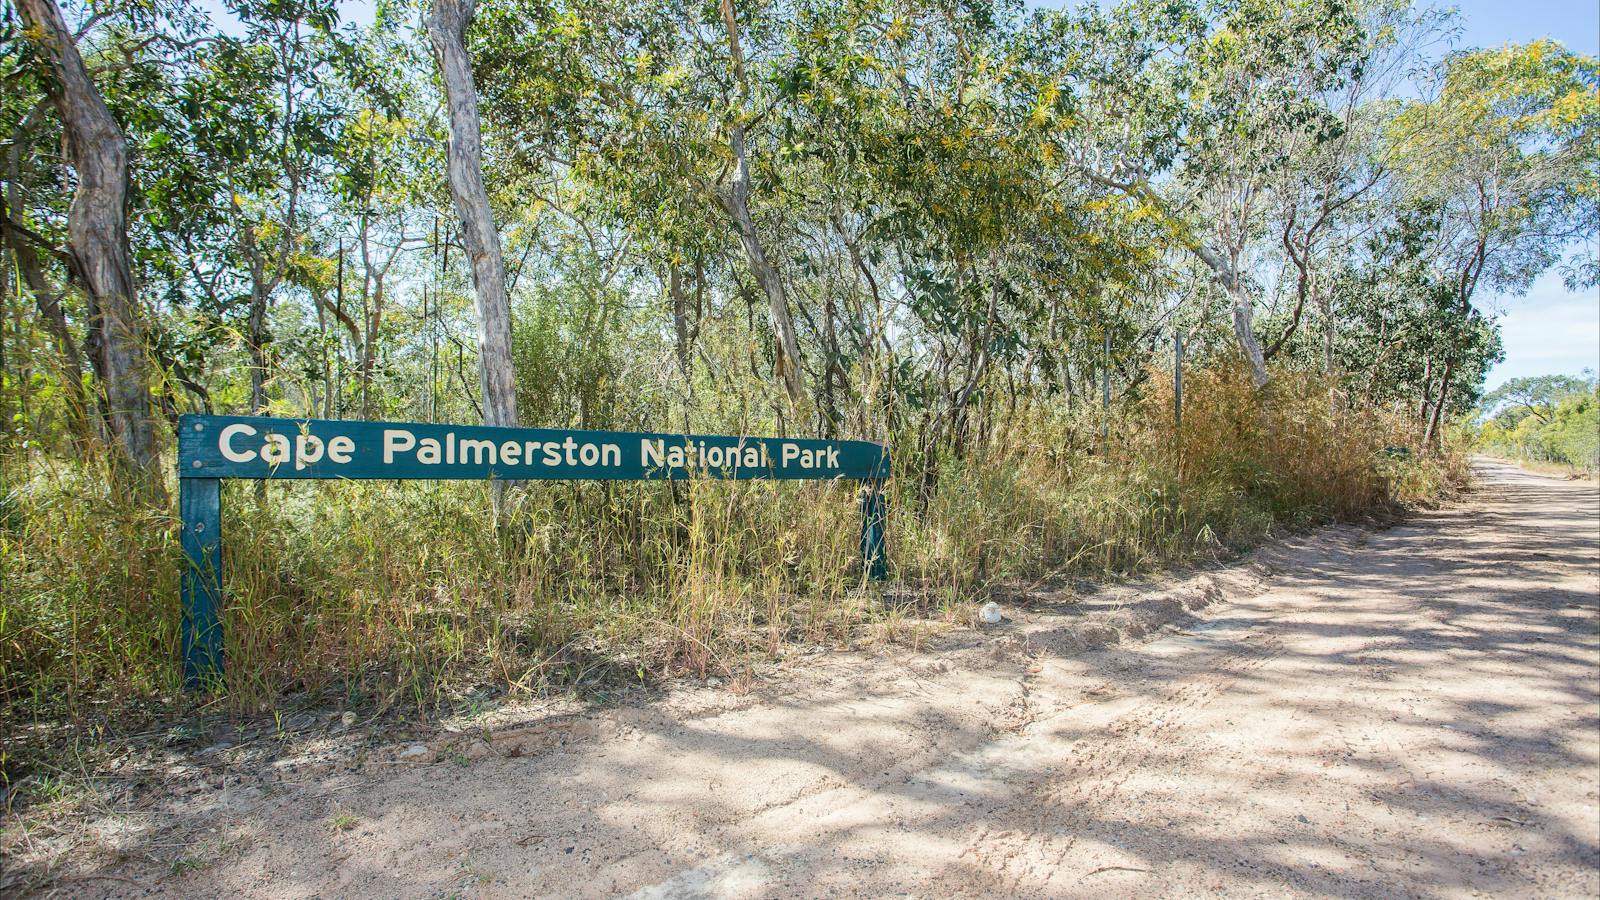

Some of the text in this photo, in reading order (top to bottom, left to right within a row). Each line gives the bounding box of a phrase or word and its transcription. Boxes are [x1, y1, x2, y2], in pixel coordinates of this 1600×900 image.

[218, 423, 356, 470] Cape
[383, 429, 622, 467] Palmerston
[782, 443, 840, 469] Park
